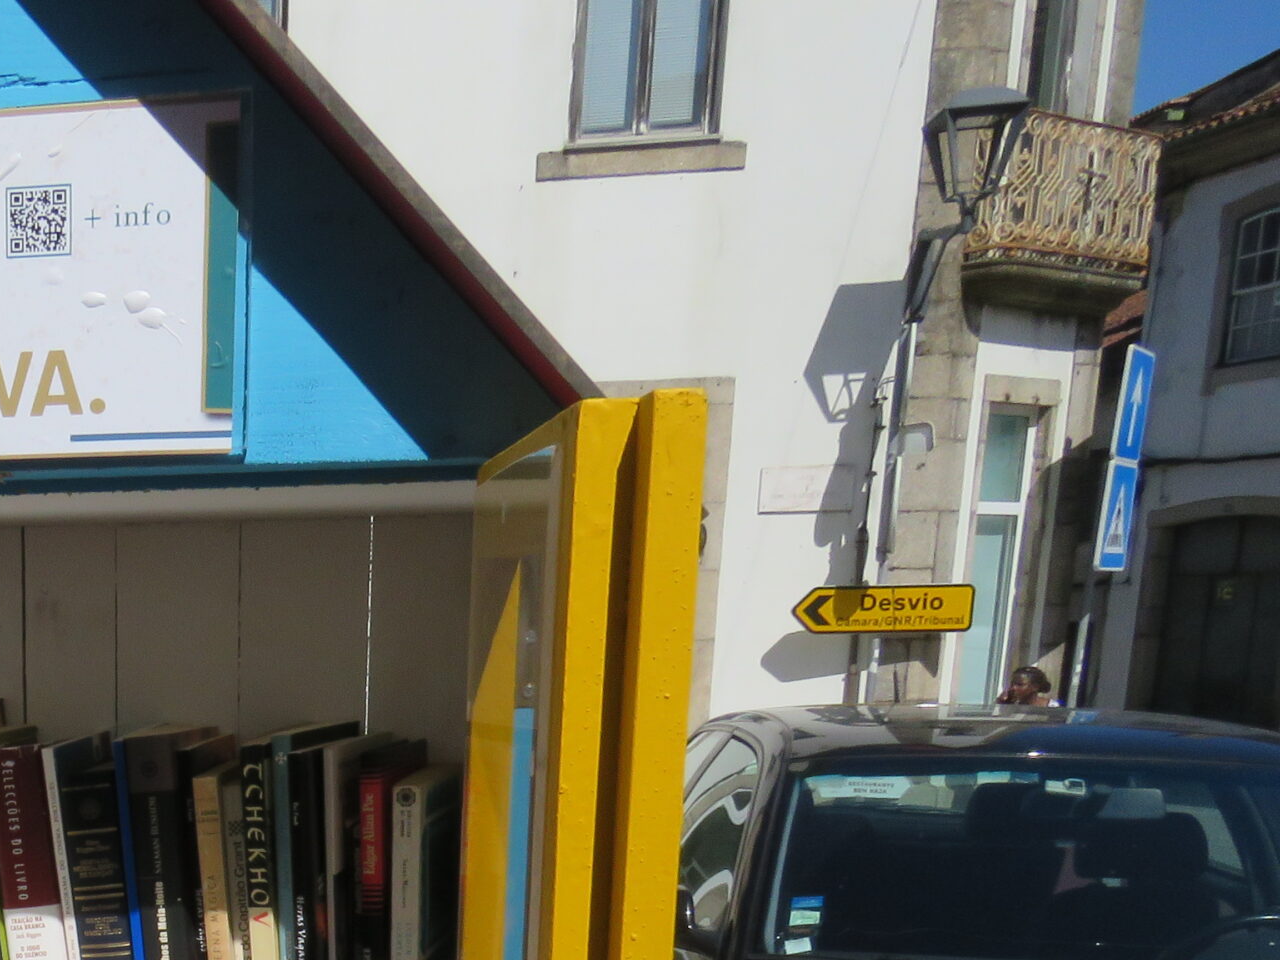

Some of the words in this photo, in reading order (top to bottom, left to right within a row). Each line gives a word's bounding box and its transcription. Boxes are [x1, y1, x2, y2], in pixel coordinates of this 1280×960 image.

[114, 203, 172, 228] info
[859, 592, 945, 613] Desvio
[361, 793, 374, 812] Poe
[362, 814, 375, 842] Allan
[11, 839, 24, 855] DO
[363, 845, 376, 875] Edgar
[234, 841, 247, 880] Grant
[14, 863, 29, 900] LIVRO
[155, 881, 168, 930] Meia-Noite
[236, 882, 250, 931] Capitão
[296, 894, 306, 924] Horas
[25, 923, 46, 931] BRANCA
[159, 931, 169, 943] da
[240, 934, 251, 951] do
